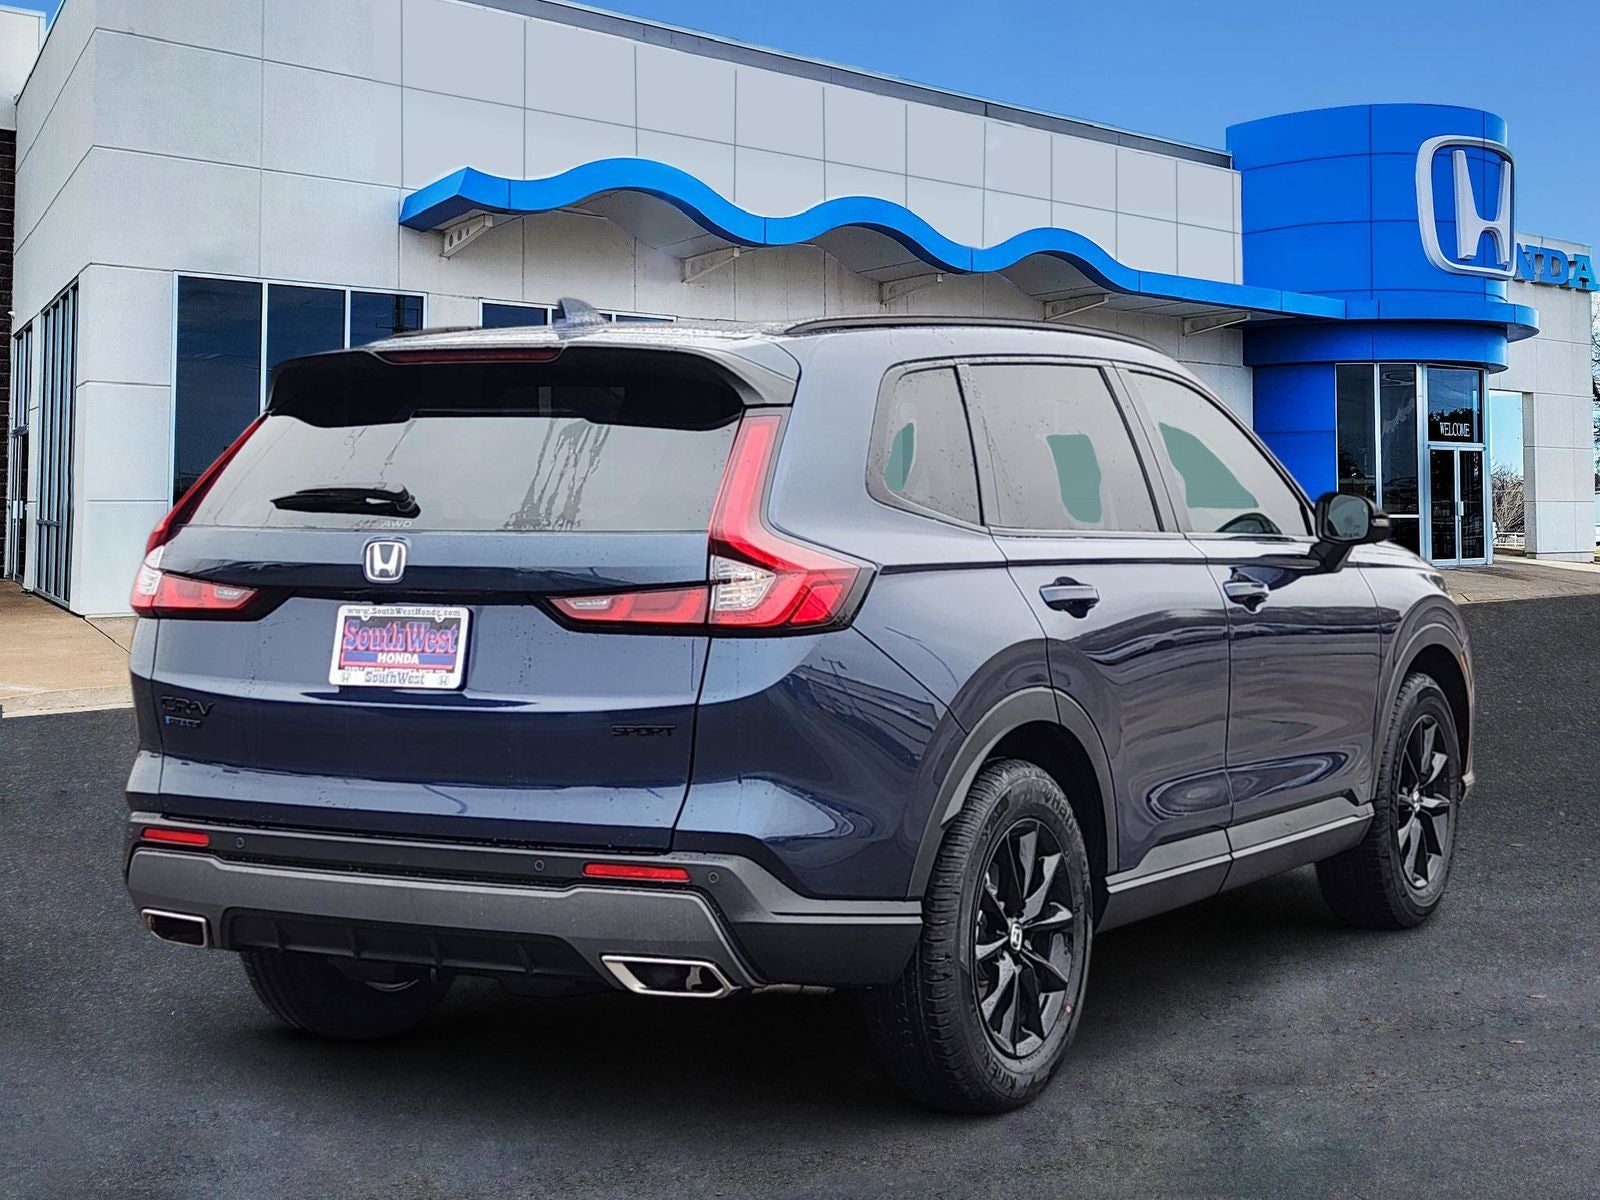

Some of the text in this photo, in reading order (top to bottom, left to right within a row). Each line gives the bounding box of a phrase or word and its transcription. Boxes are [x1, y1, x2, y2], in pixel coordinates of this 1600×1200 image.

[1513, 242, 1600, 292] NDA
[1439, 421, 1471, 438] WELCOME
[343, 619, 459, 653] SouthWest
[376, 652, 420, 664] HONDA
[611, 724, 676, 737] SPORT
